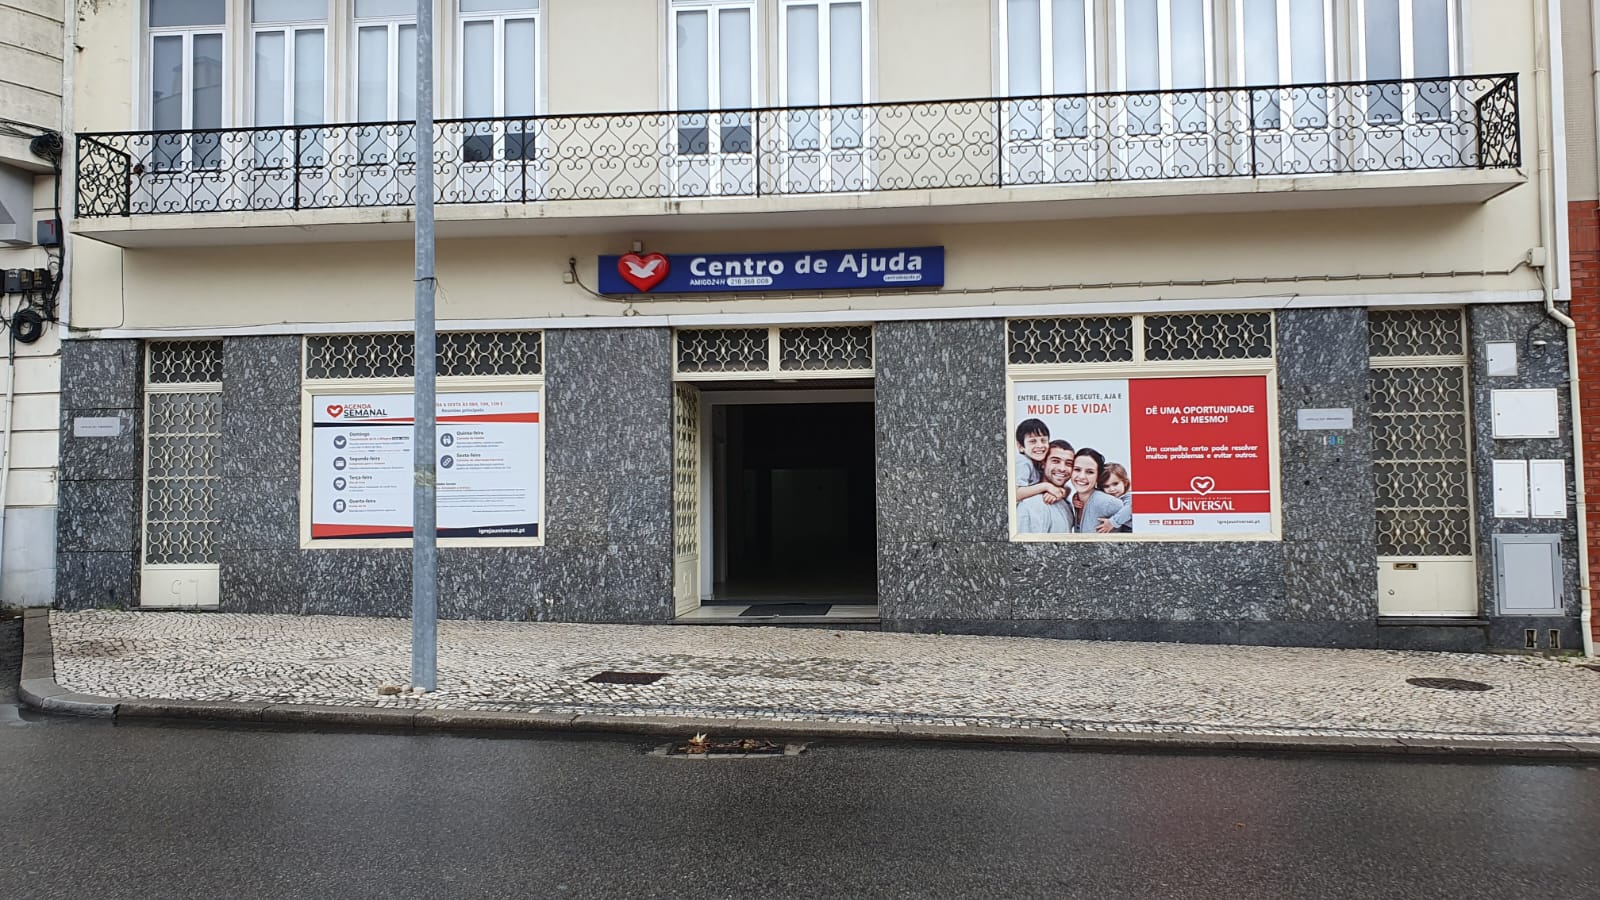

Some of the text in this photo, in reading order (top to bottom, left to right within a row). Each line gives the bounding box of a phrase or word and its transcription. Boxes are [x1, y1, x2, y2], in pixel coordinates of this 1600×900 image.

[690, 252, 922, 278] Centro de Ajuda
[344, 408, 388, 416] SEMANAL
[1027, 403, 1112, 414] MUDE DE VIDA!
[1145, 405, 1158, 414] DÊ
[1183, 405, 1254, 414] OPORTUNIDADE
[1172, 416, 1179, 424] A
[1190, 415, 1228, 423] MESMO!
[1211, 444, 1228, 452] pode
[1170, 452, 1204, 460] problemas
[1169, 497, 1235, 511] UNIVERSAL
[478, 527, 526, 535] igrejauniversal.pt
